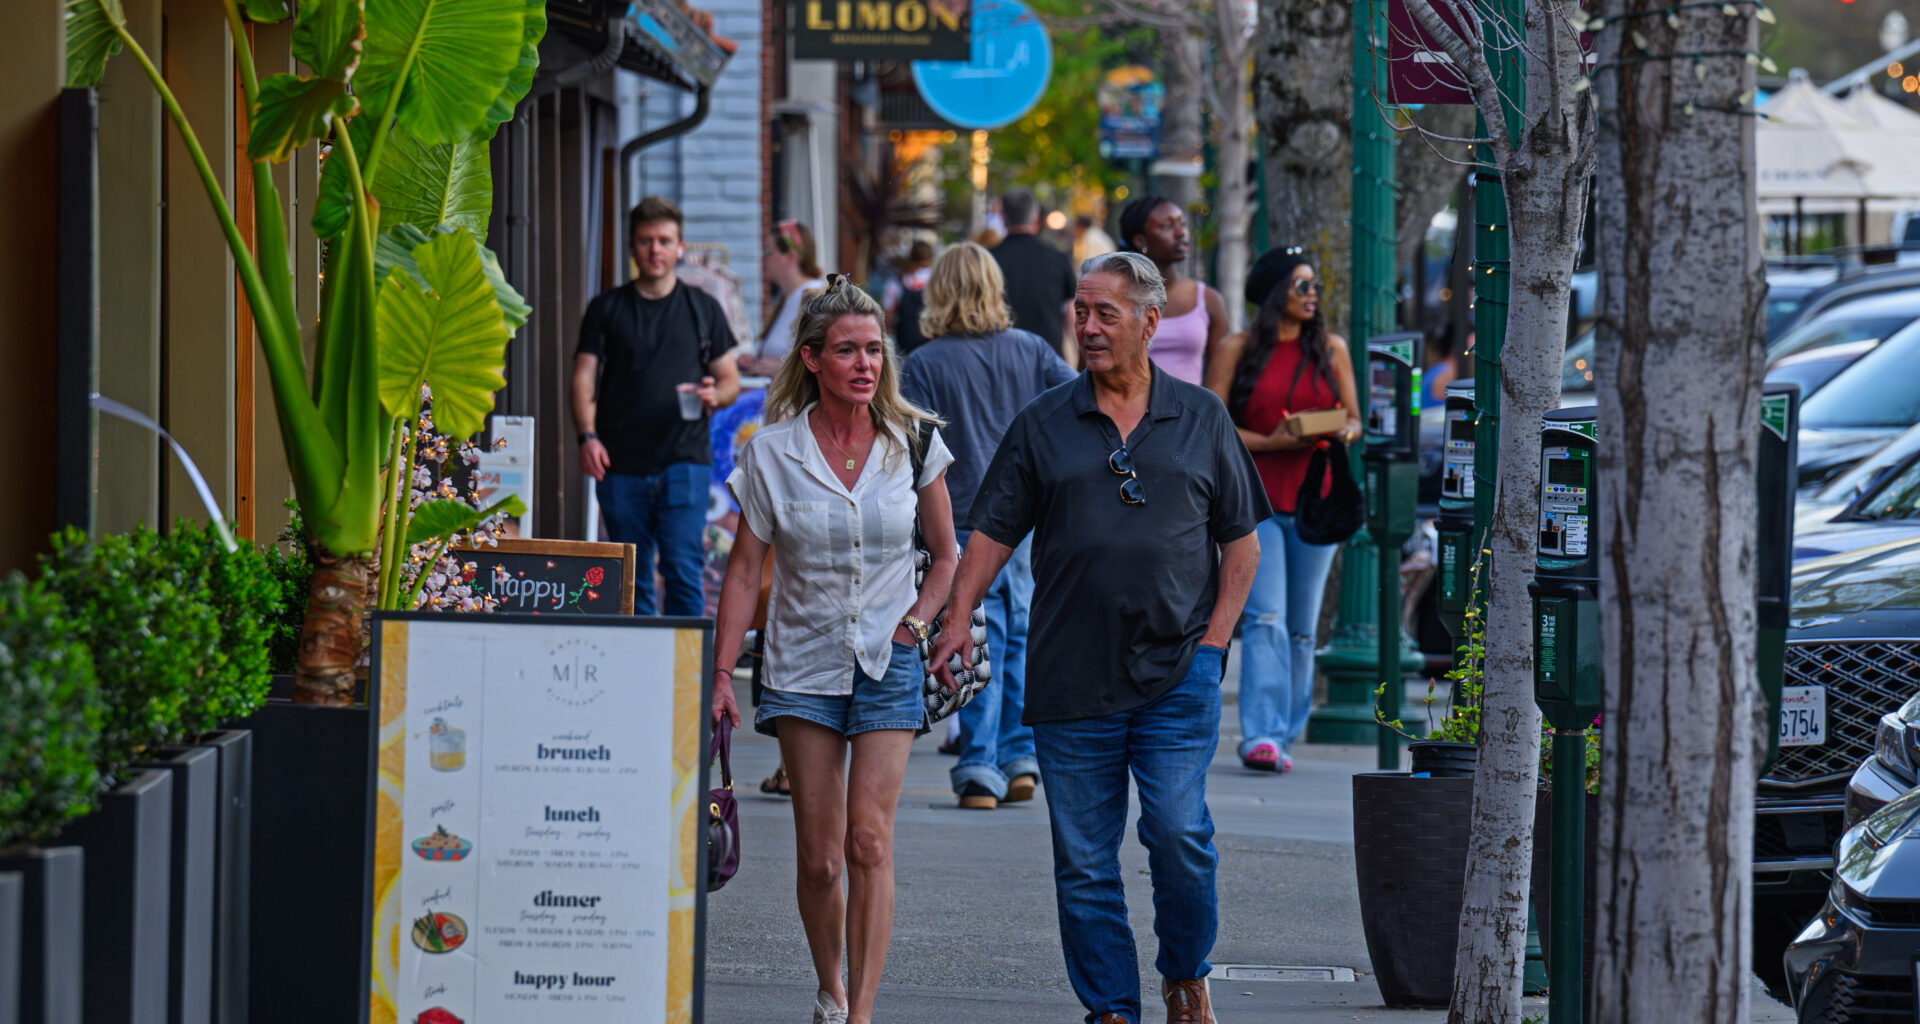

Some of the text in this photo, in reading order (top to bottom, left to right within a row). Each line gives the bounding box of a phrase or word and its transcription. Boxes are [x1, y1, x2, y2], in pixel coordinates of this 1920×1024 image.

[1541, 614, 1549, 627] 3
[553, 664, 598, 682] M R
[537, 743, 611, 761] brunch
[544, 805, 601, 823] lunch
[533, 889, 601, 908] dinner
[513, 970, 616, 990] happy hour
